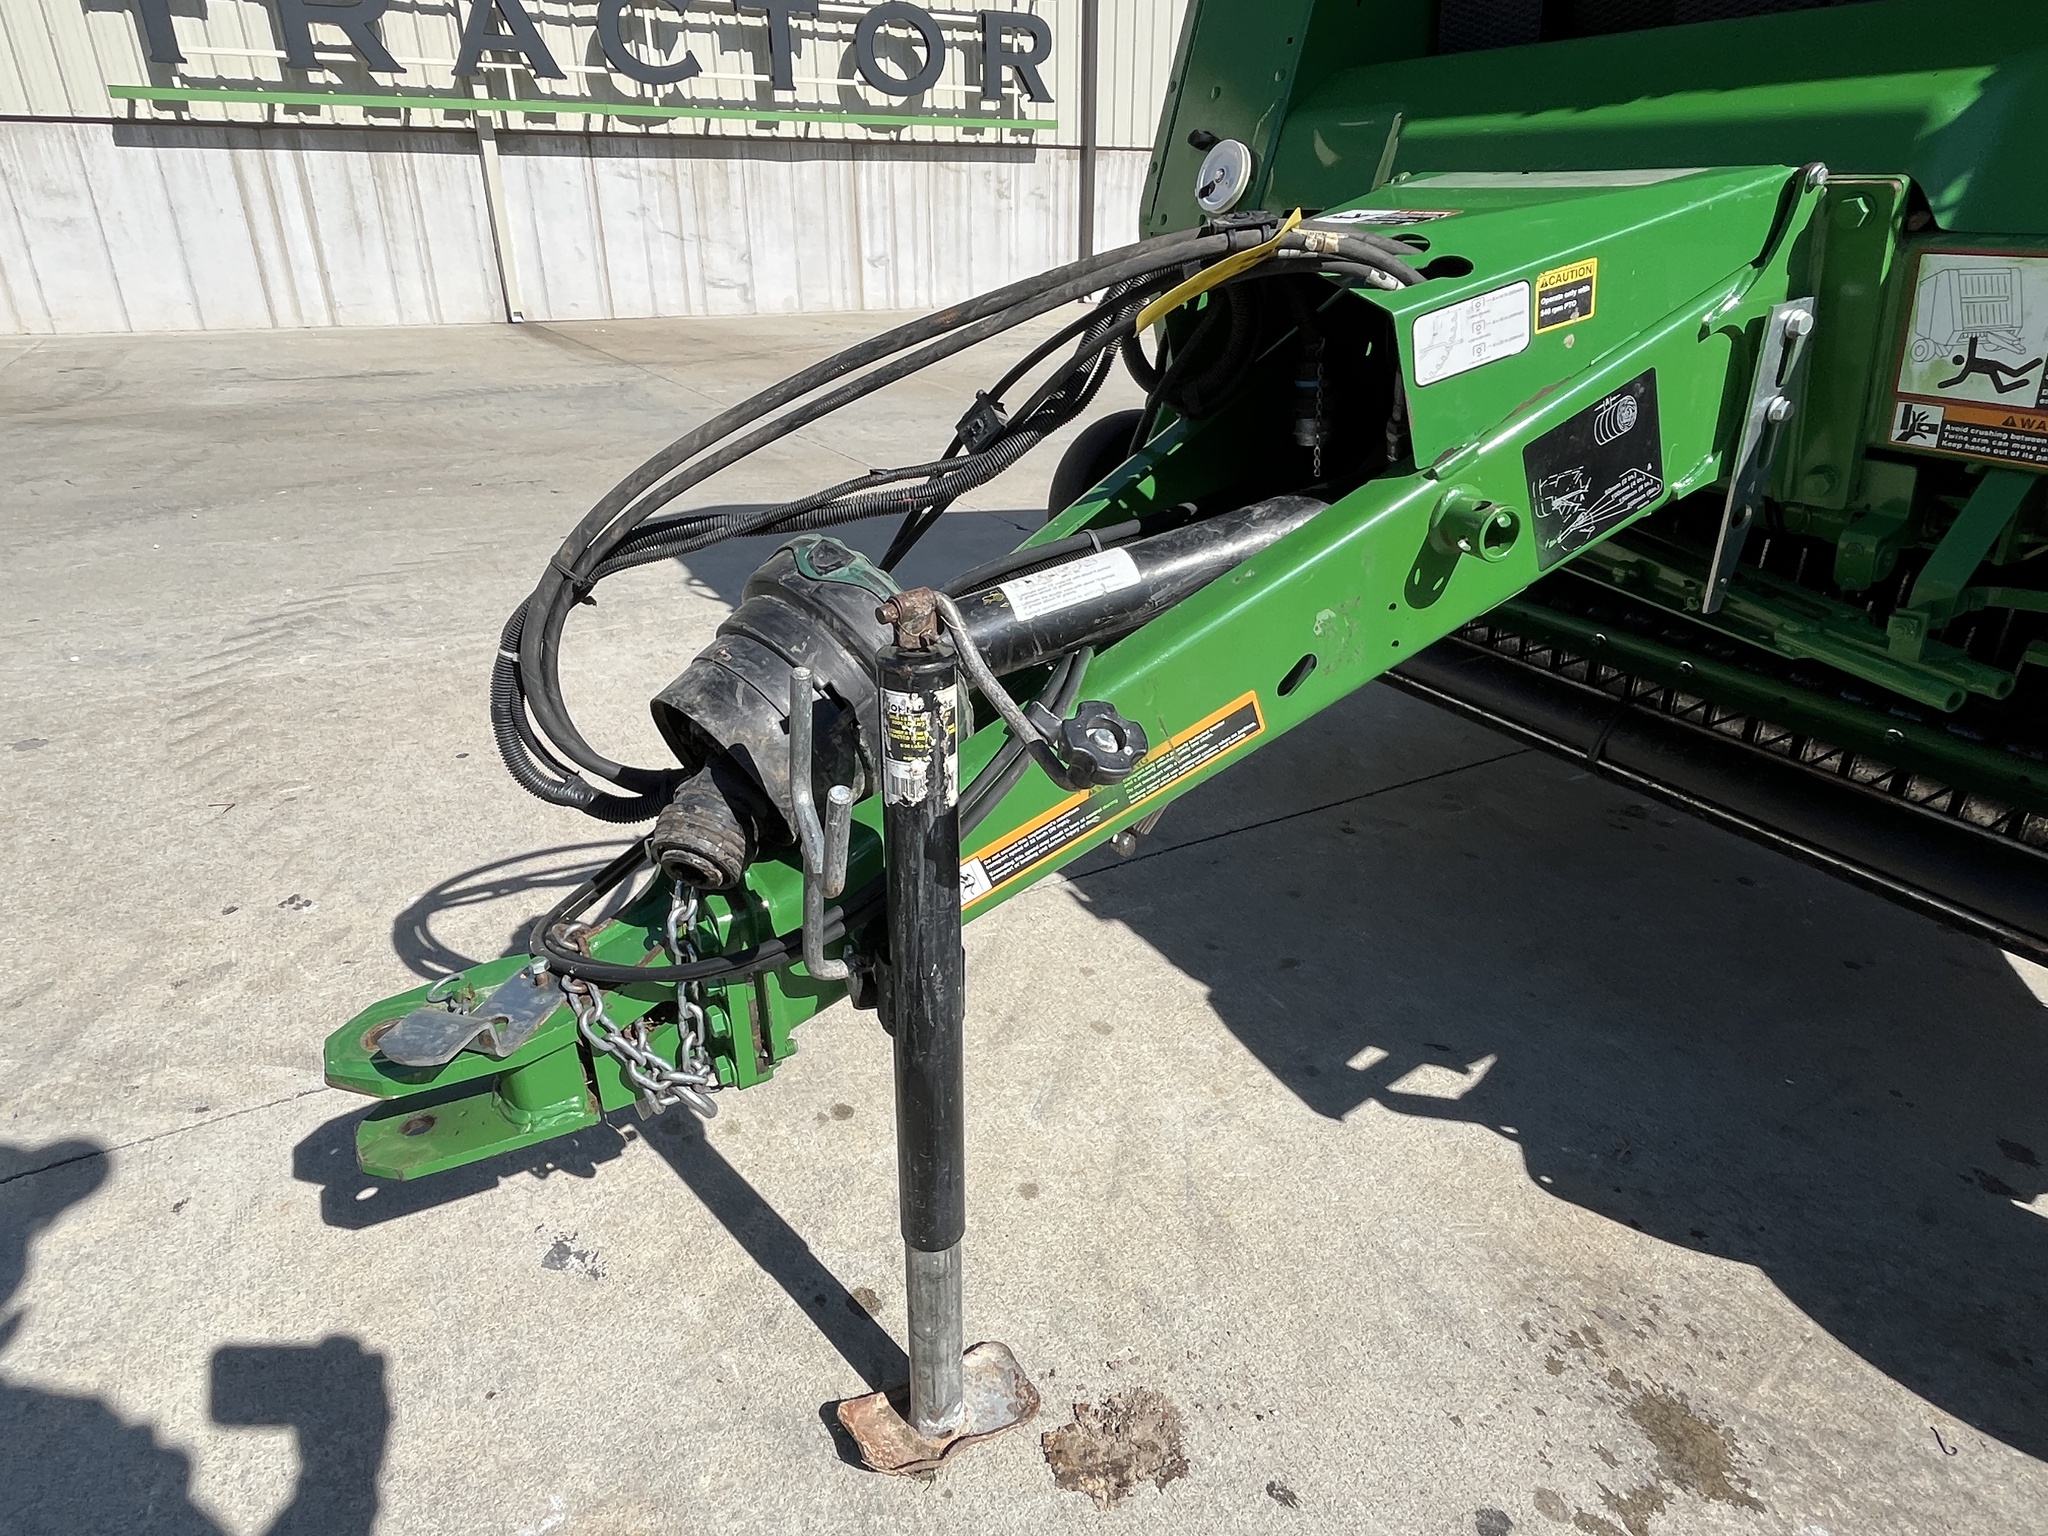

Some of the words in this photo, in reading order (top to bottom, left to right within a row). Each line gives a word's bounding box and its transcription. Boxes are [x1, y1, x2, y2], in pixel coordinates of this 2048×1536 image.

[1549, 265, 1593, 285] CAUTION
[1564, 289, 1577, 298] only
[1564, 299, 1577, 309] PTO
[1944, 432, 1969, 441] Twine
[2011, 442, 2037, 451] move
[1945, 424, 1969, 433] Avoid
[1970, 427, 2008, 440] crushing
[2010, 433, 2047, 444] between
[1941, 440, 1962, 449] Keep
[1964, 443, 1990, 453] hands
